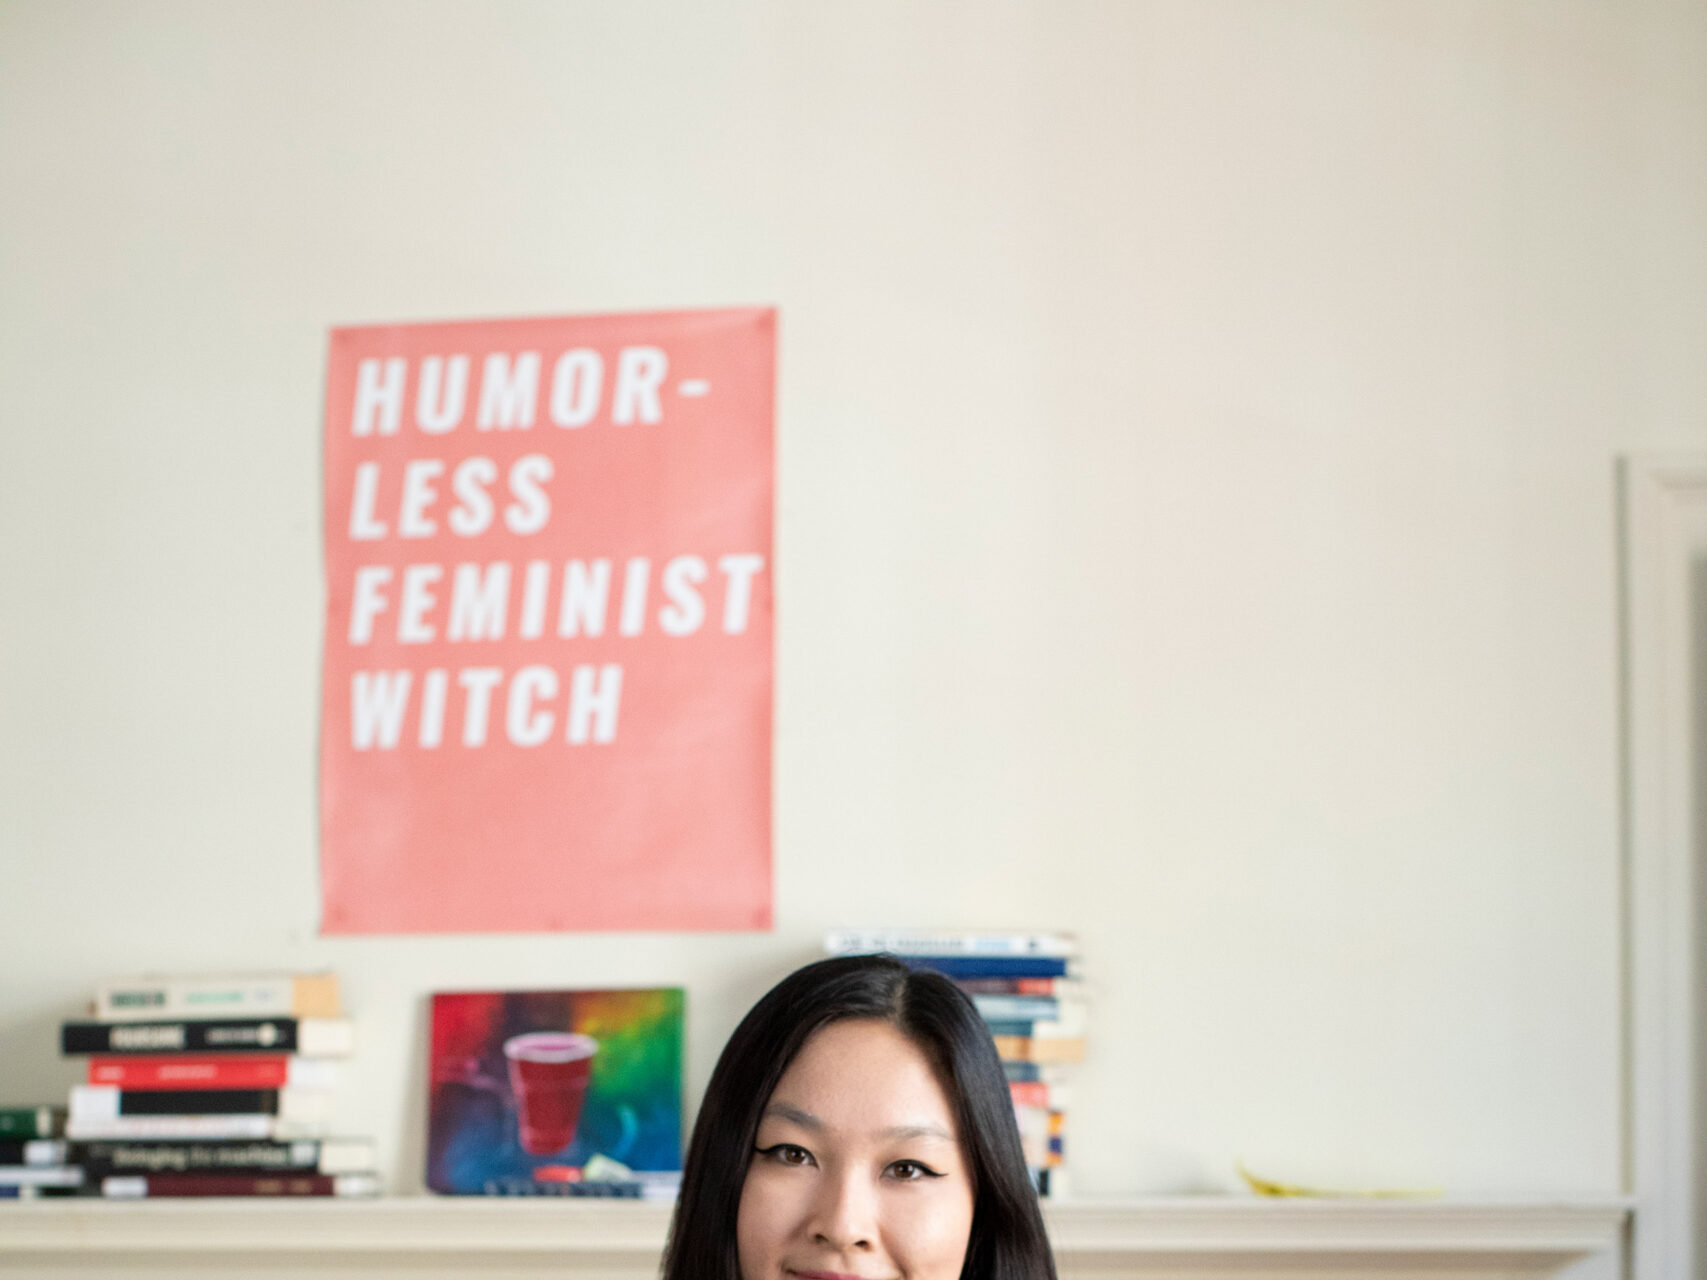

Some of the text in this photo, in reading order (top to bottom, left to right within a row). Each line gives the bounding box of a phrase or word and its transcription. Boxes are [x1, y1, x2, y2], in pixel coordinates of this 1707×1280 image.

[351, 346, 711, 437] HUMOR-
[349, 455, 555, 540] LESS
[348, 554, 765, 645] FEMINIST
[351, 663, 625, 751] WITCH
